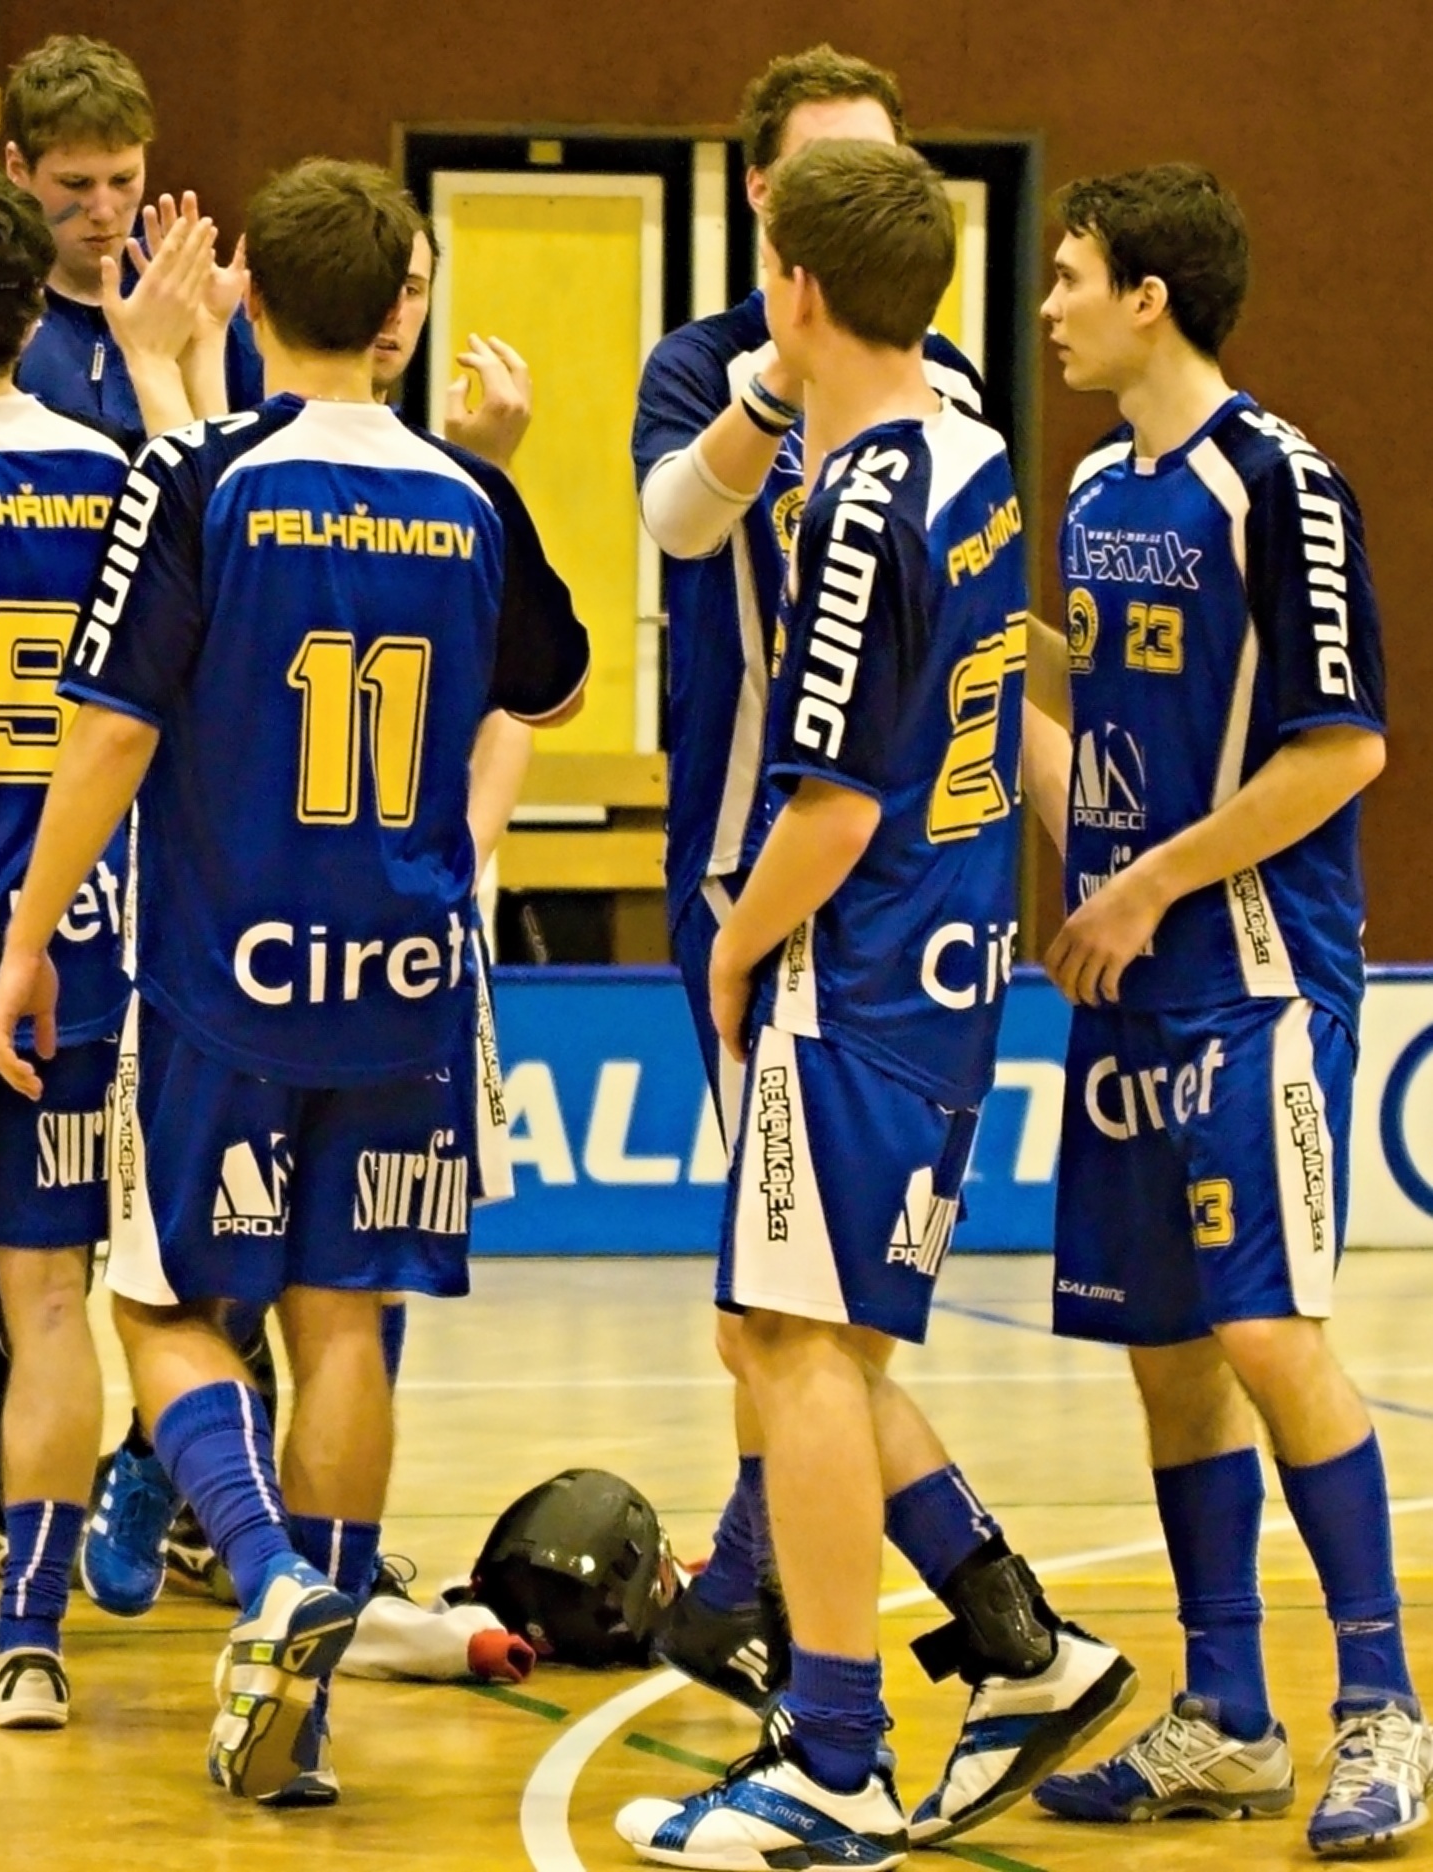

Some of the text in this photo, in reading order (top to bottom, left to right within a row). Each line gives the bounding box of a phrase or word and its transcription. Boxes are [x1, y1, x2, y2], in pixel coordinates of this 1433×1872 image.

[248, 503, 475, 559] PELHŘIMOV
[794, 444, 909, 760] SALMING
[1125, 601, 1185, 675] 23
[287, 631, 432, 828] 11
[234, 912, 464, 1004] Ciret
[1187, 1178, 1236, 1249] 3
[1057, 1280, 1126, 1303] SALMING
